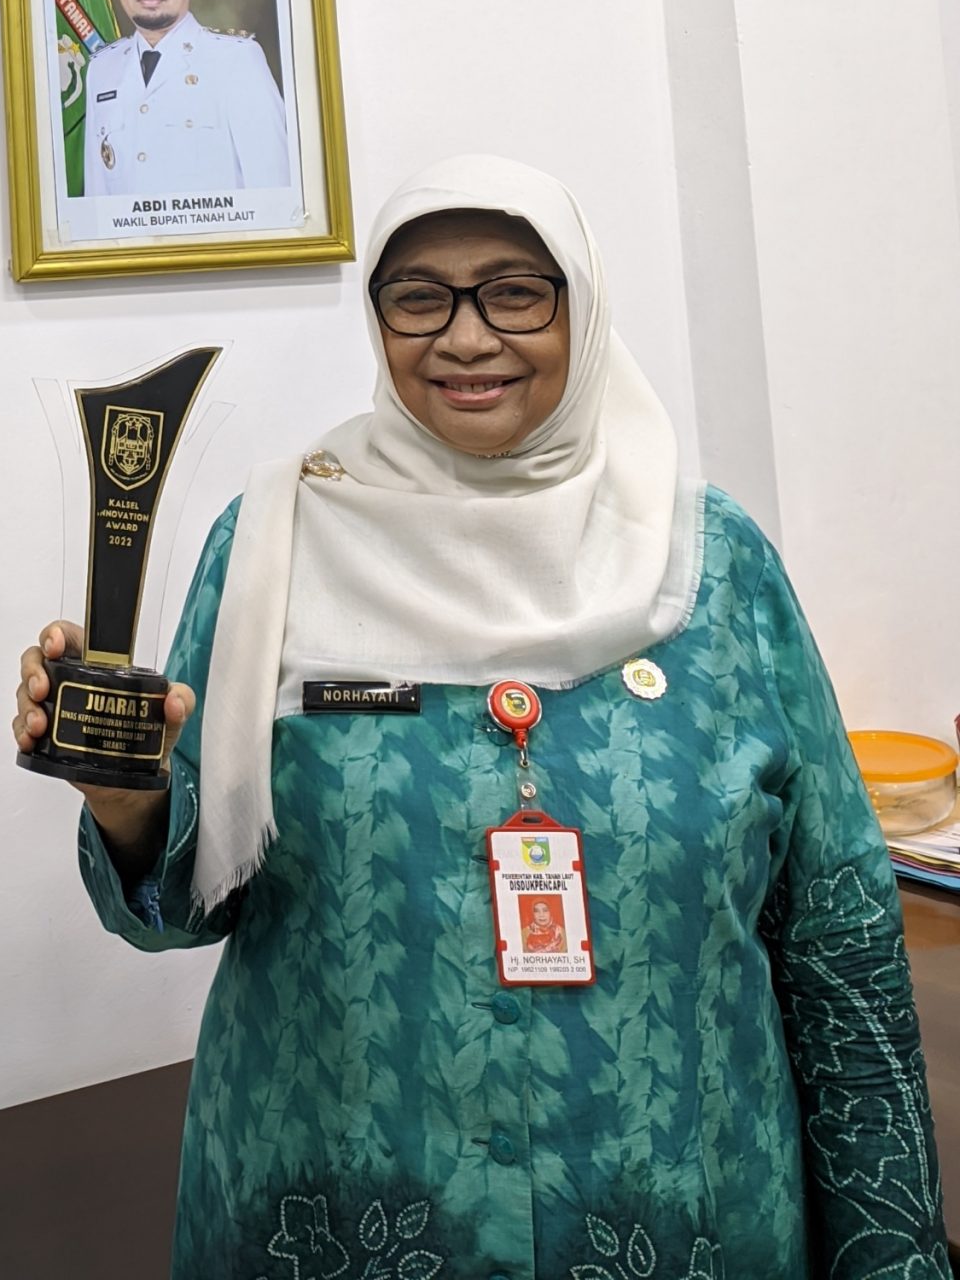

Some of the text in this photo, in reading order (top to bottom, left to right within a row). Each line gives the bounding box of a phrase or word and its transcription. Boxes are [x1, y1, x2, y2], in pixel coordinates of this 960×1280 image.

[132, 196, 234, 213] ABDI RAHMAN
[113, 210, 255, 228] WAKIL BUPATI TANAH LAUT
[108, 498, 139, 510] KALSEL
[106, 521, 138, 532] AWARD
[109, 535, 132, 547] 2022
[323, 690, 399, 703] NORHAYATI
[86, 693, 149, 718] JUARA 3
[60, 709, 77, 721] DINAS
[509, 880, 568, 891] DISDUKPENCAPIL
[523, 956, 572, 965] NORHAYATI,
[574, 956, 586, 964] SH
